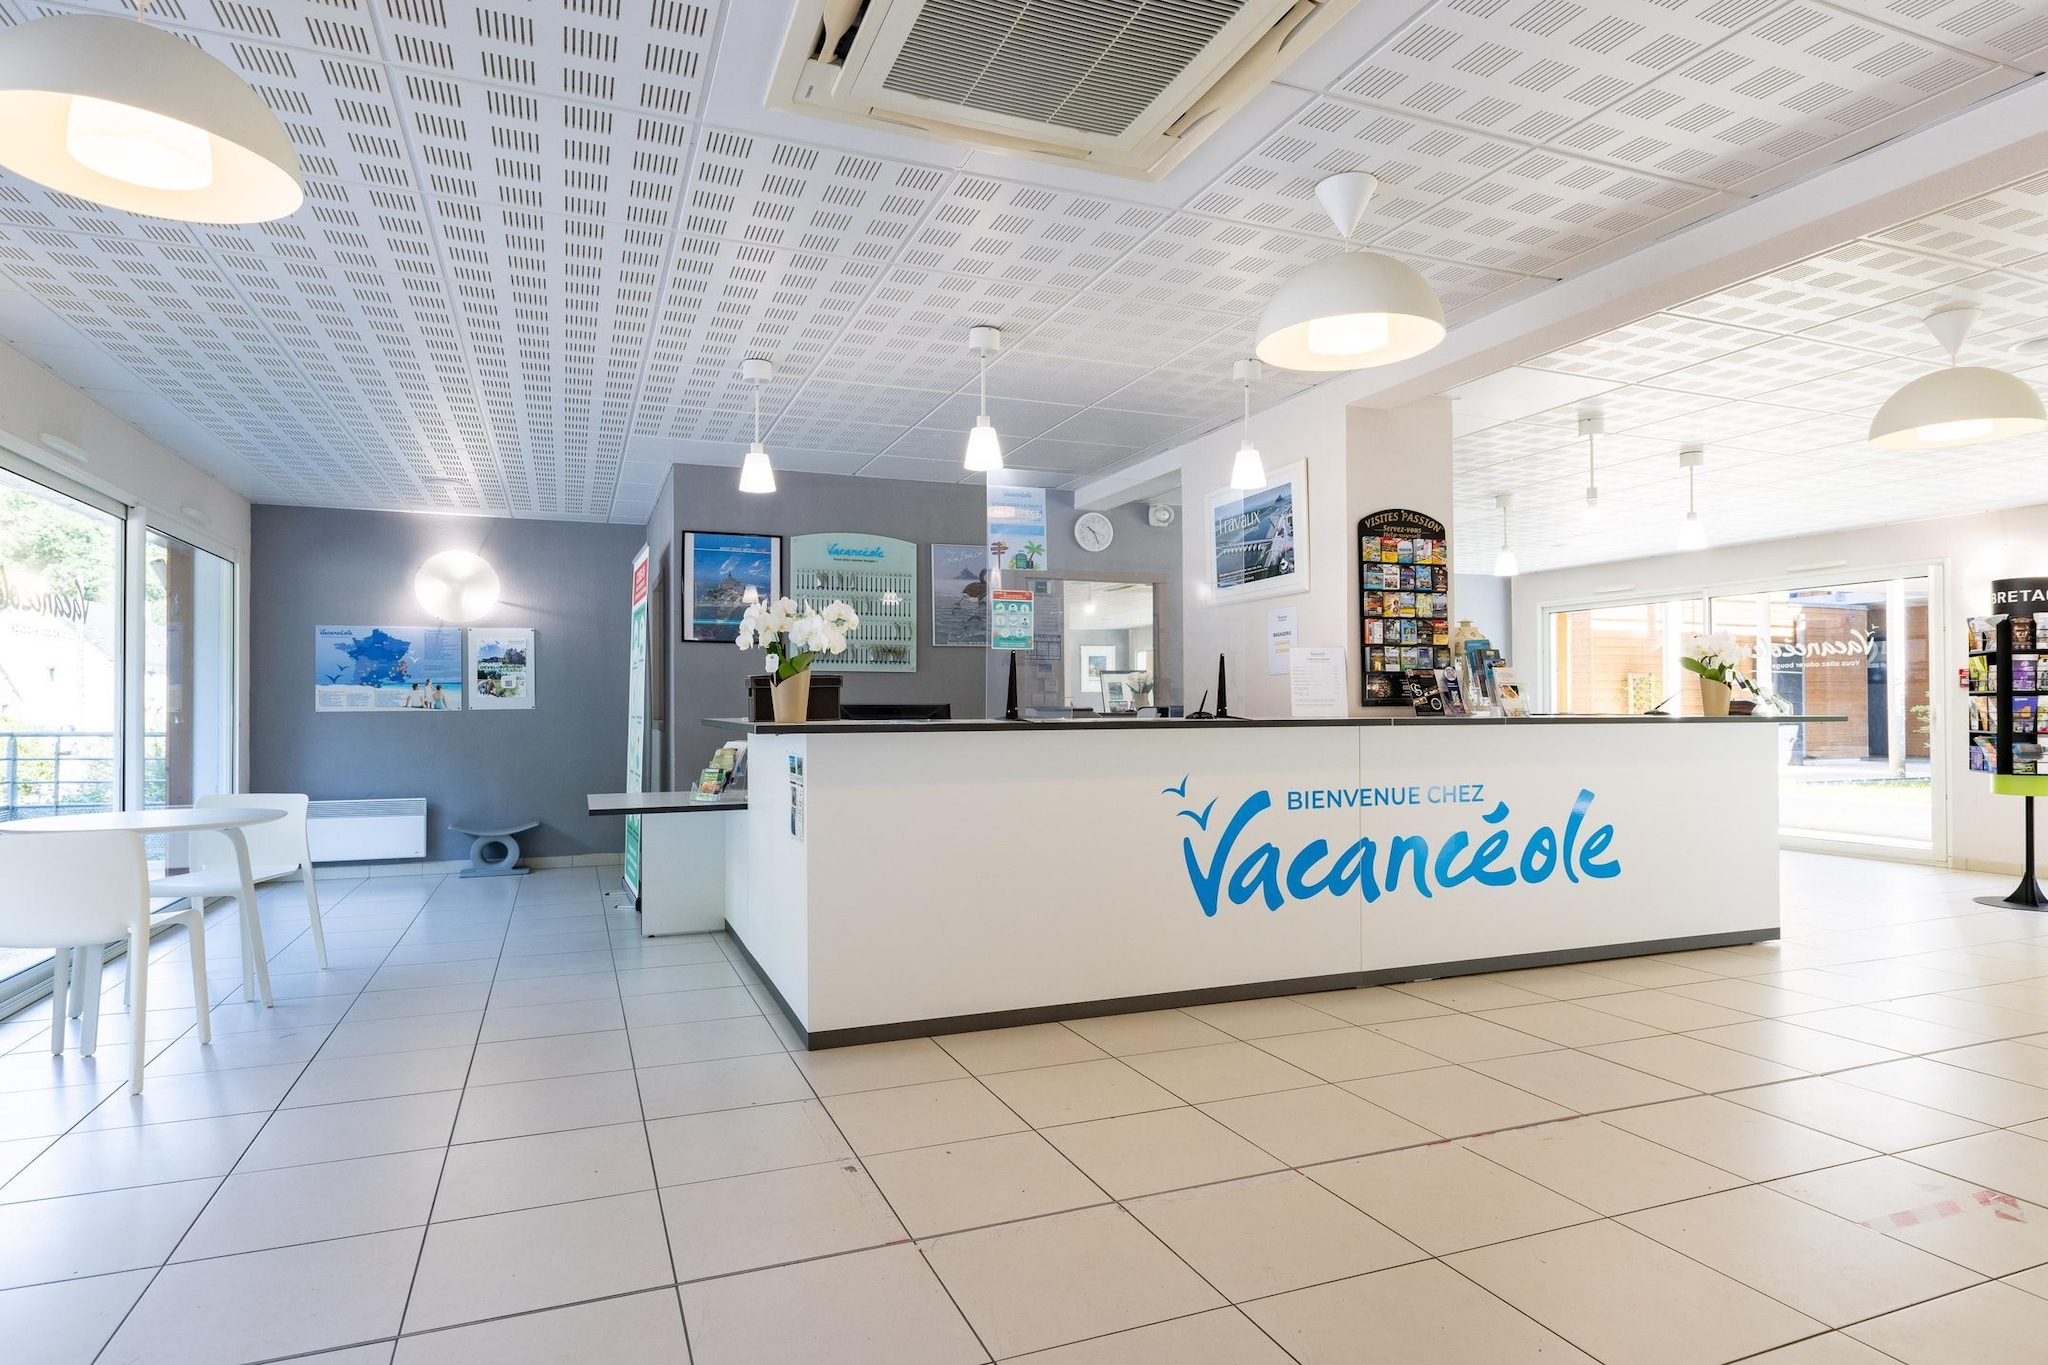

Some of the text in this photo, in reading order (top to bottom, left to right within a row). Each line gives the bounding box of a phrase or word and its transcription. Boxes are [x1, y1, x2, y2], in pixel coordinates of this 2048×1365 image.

[1219, 509, 1261, 535] Travaux
[1365, 512, 1441, 533] VISITES PASSION
[1382, 525, 1422, 534] Servez-vous
[827, 543, 885, 558] Vacancéole
[1991, 589, 2048, 605] BRETA
[1287, 784, 1485, 810] BIENVENUE CHEZ
[1183, 788, 1622, 918] Vacancéole
